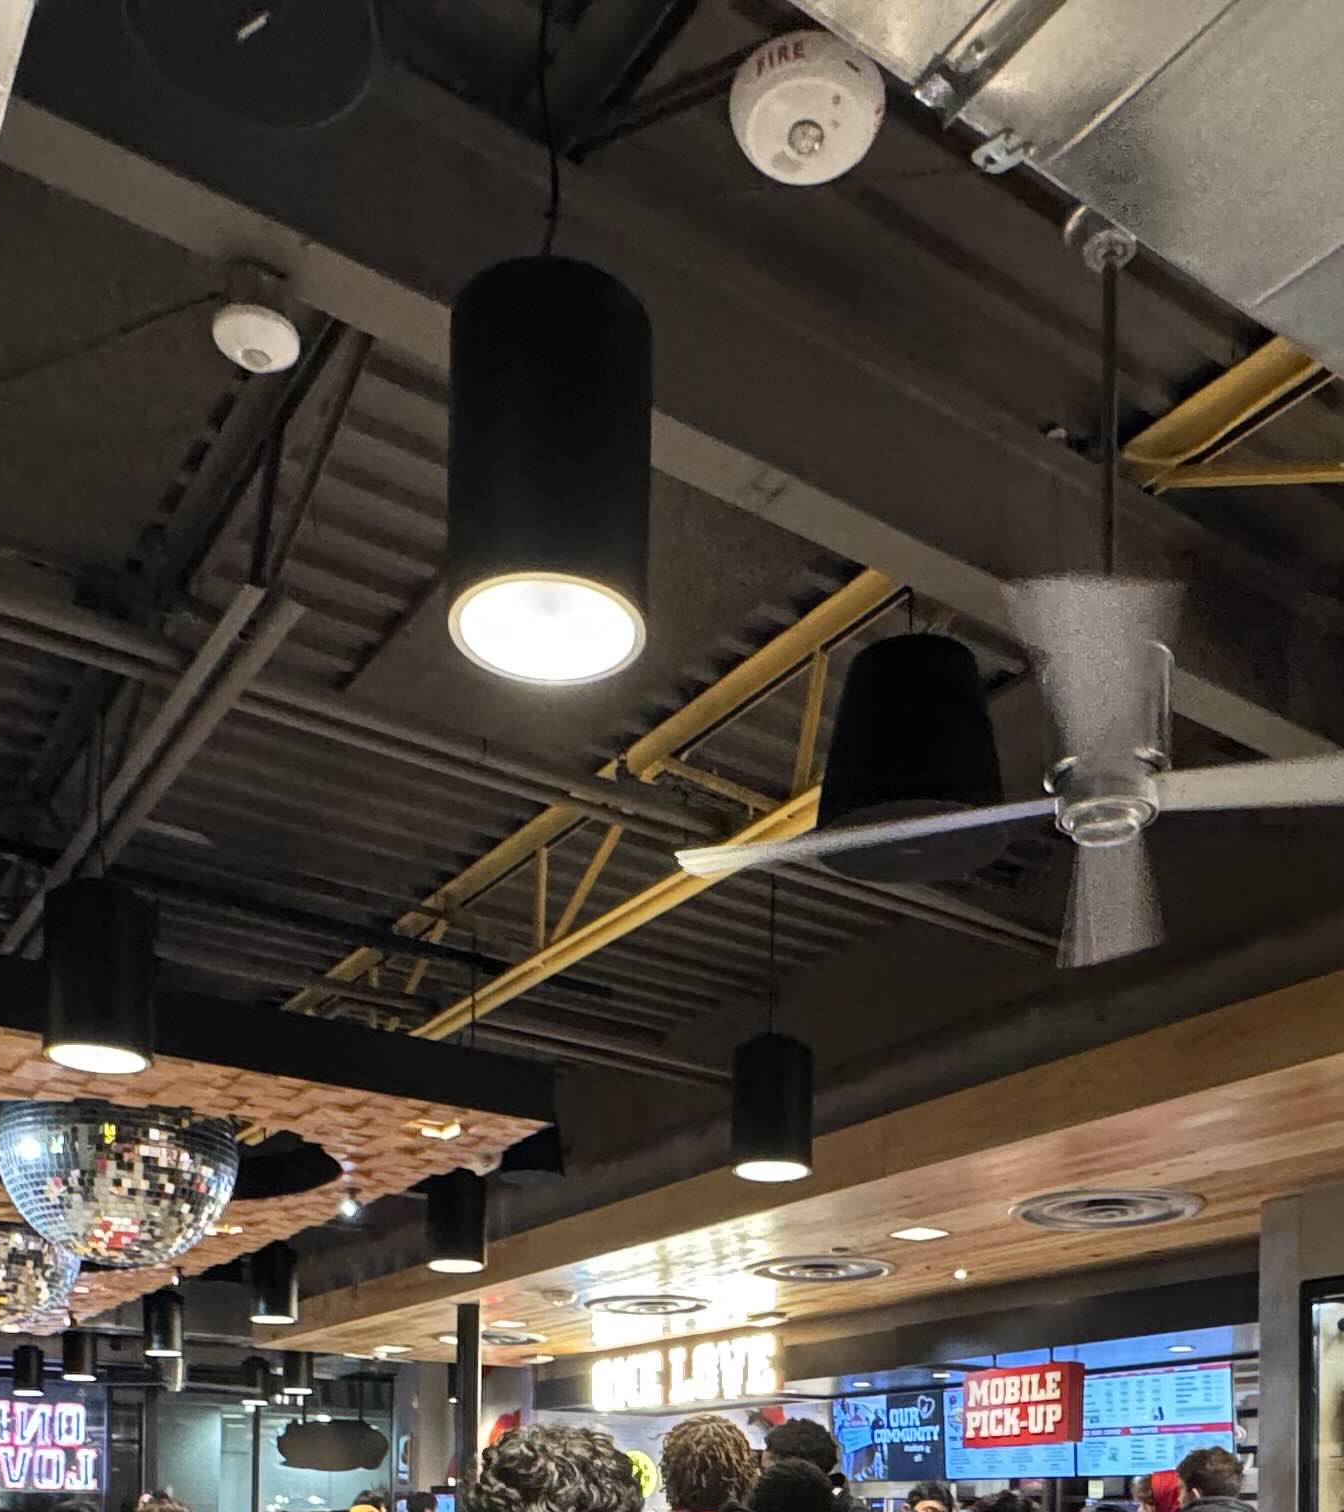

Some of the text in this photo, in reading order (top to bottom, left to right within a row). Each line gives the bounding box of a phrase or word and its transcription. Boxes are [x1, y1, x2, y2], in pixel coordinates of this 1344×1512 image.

[756, 40, 806, 77] FIRE
[967, 1371, 1061, 1407] MOBILE
[874, 1425, 940, 1444] COMMUNITY
[888, 1407, 920, 1428] OUR
[965, 1404, 1062, 1439] PICK-UP
